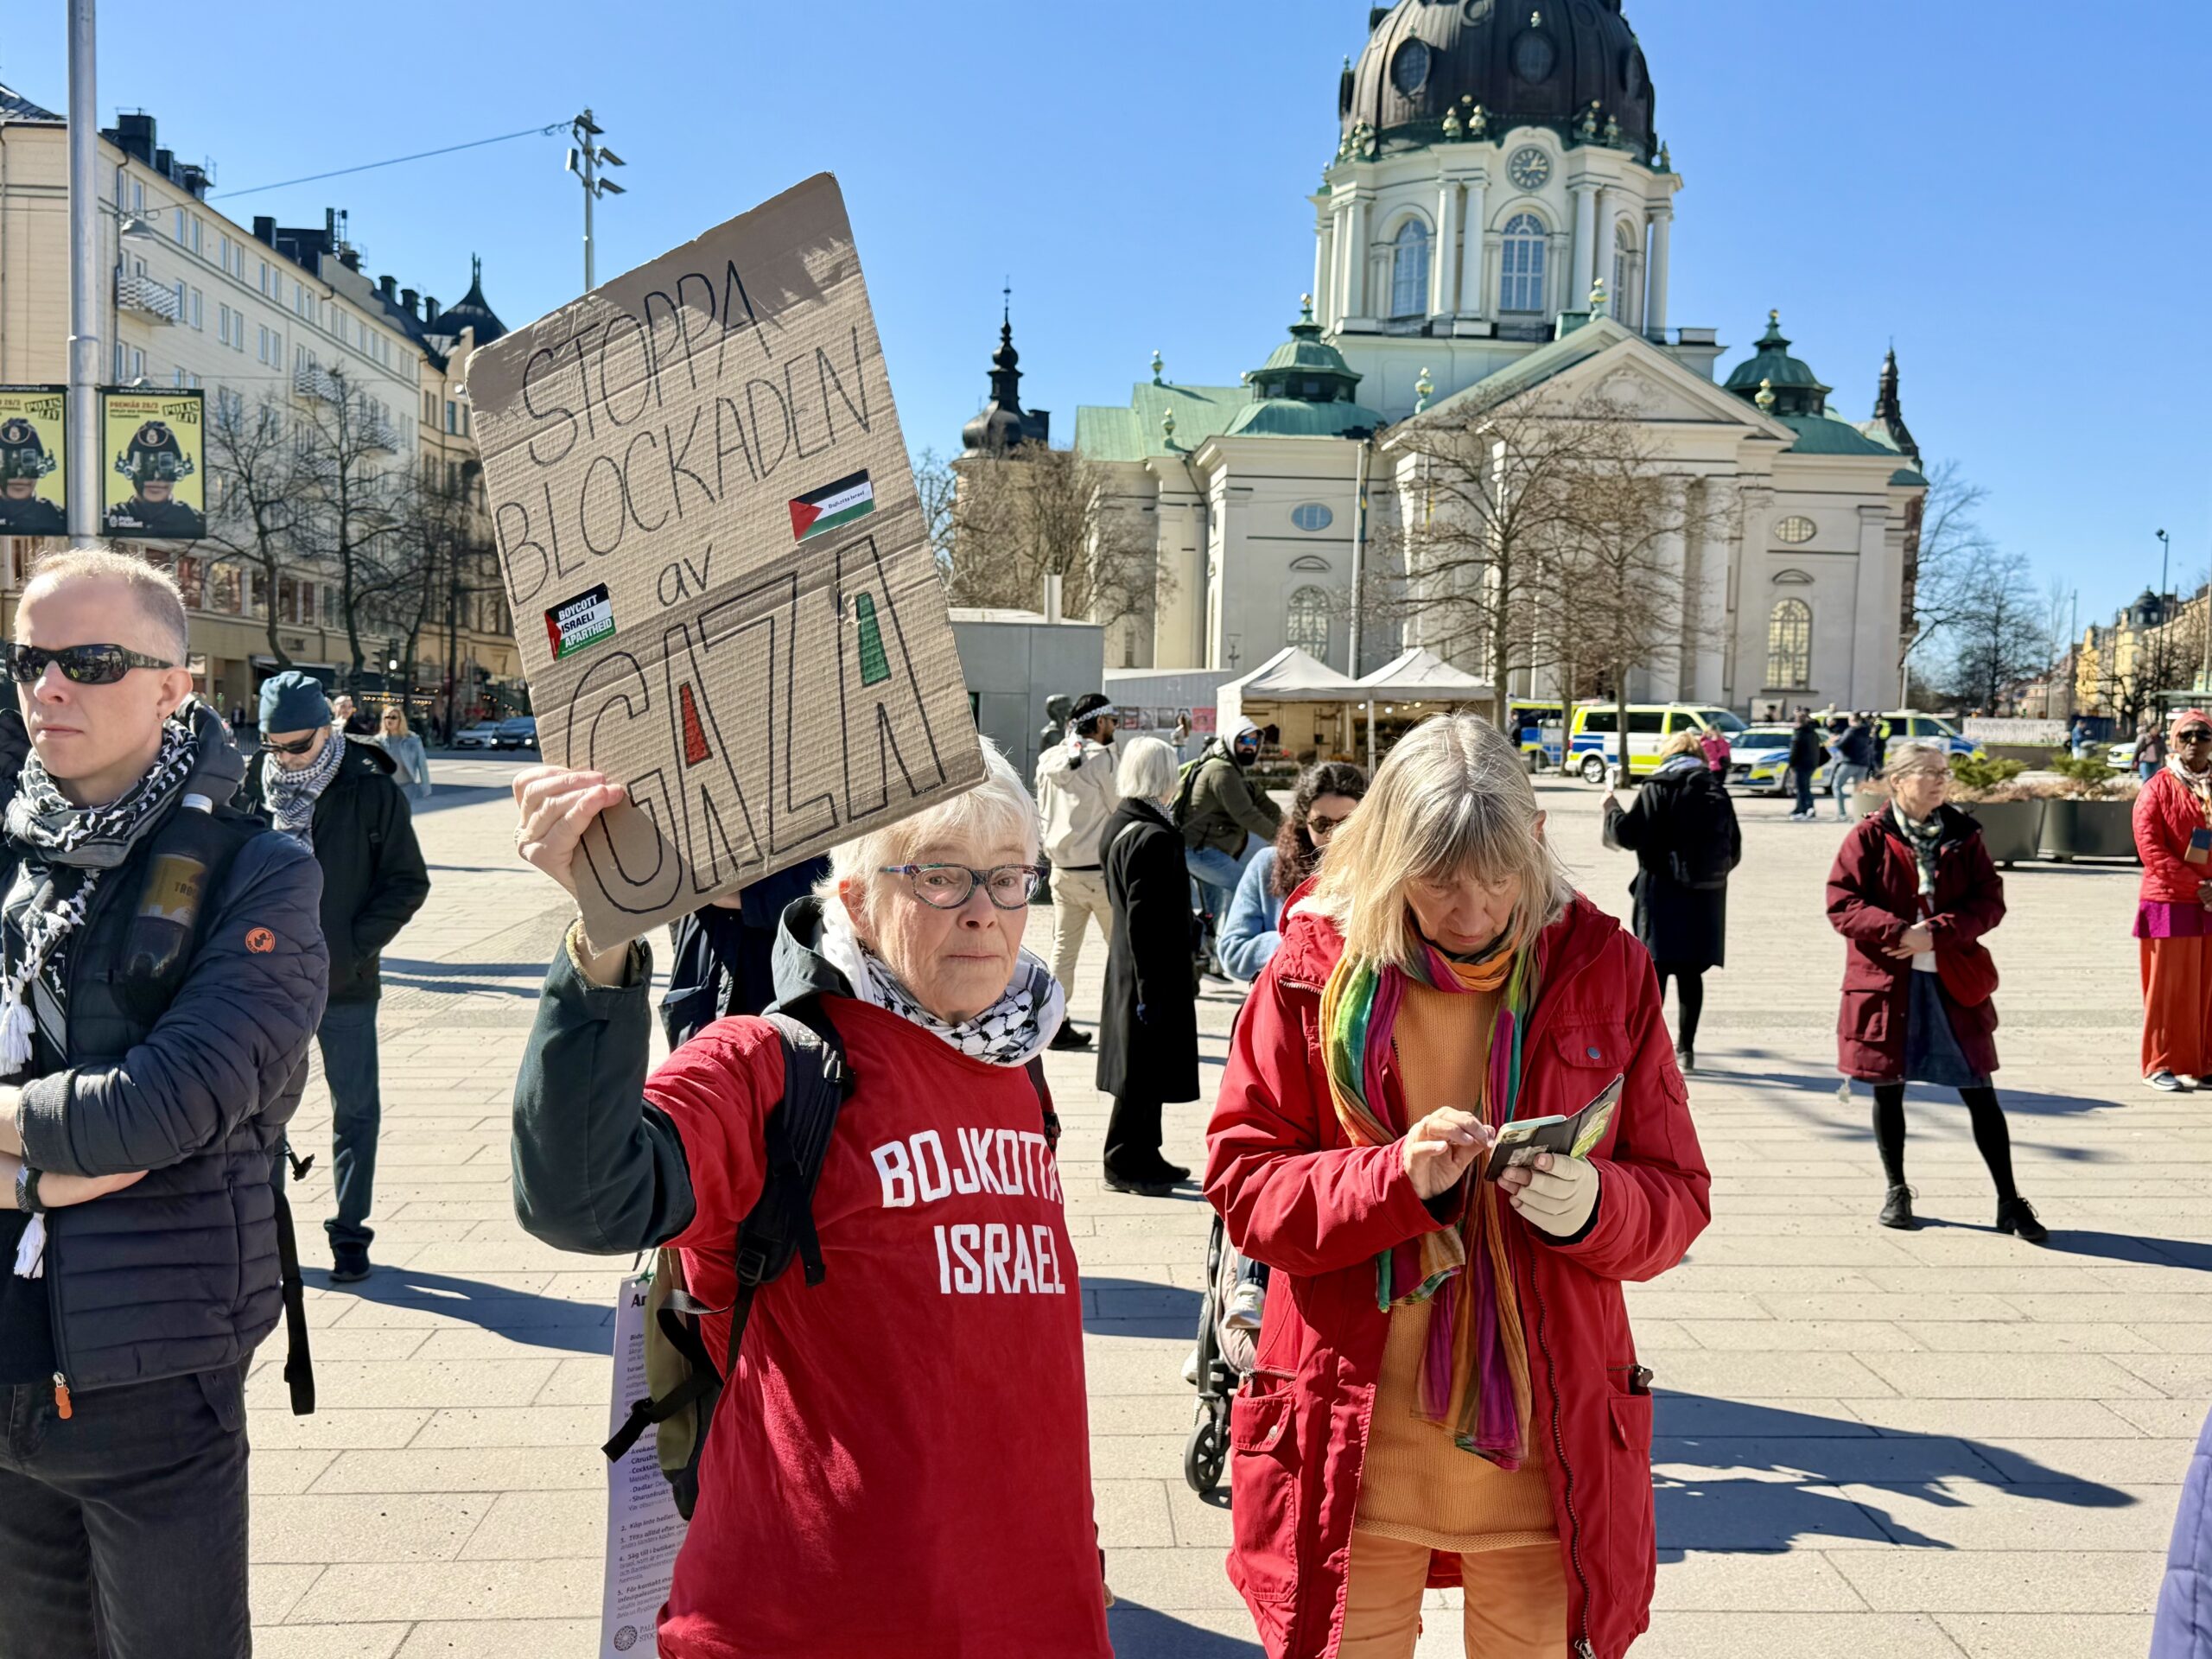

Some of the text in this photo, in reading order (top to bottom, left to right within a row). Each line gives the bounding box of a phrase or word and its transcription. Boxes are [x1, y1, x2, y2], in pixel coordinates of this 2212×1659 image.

[522, 259, 772, 468] STOPPA
[163, 401, 200, 416] POLIS
[495, 326, 872, 607] BLOCKADEN
[558, 594, 597, 621] BOYCOTT
[657, 543, 713, 607] av
[561, 611, 595, 635] ISRAELI
[565, 618, 613, 648] APARTHEID
[566, 534, 948, 914] GAZA
[870, 1127, 1063, 1208] BOJKOTTA
[933, 1223, 1066, 1294] ISRAEL
